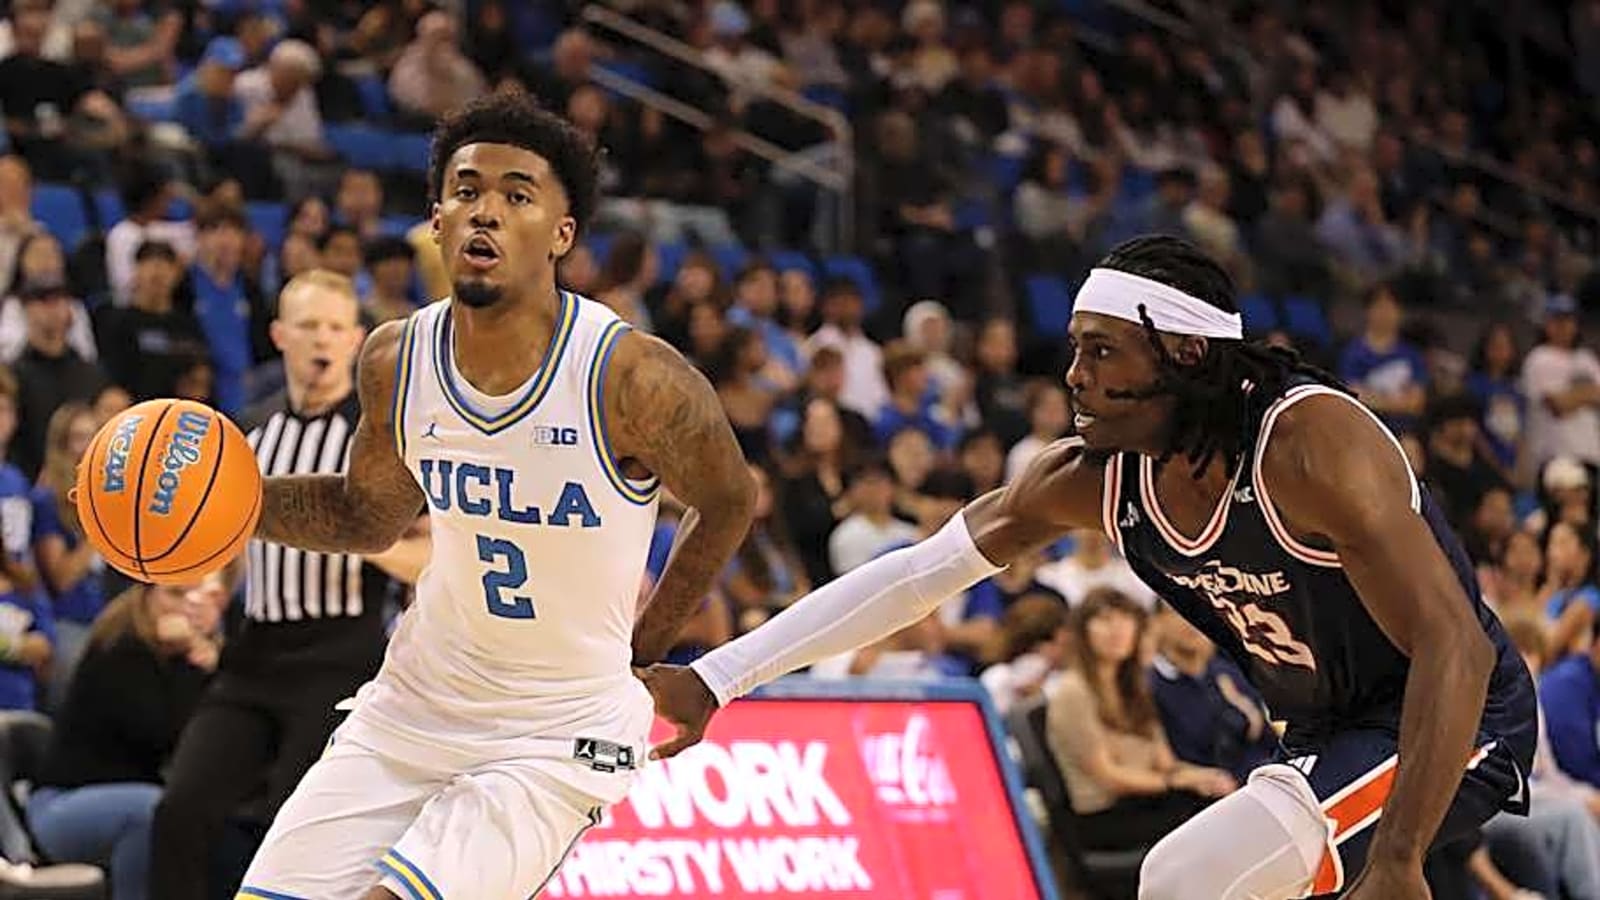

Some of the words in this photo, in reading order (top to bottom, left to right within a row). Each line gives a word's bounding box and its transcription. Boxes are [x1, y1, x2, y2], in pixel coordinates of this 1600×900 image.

[148, 410, 211, 515] Wilson
[420, 459, 601, 528] UCLA
[476, 534, 536, 619] 2
[629, 739, 853, 828] WORK
[724, 837, 873, 894] WORK
